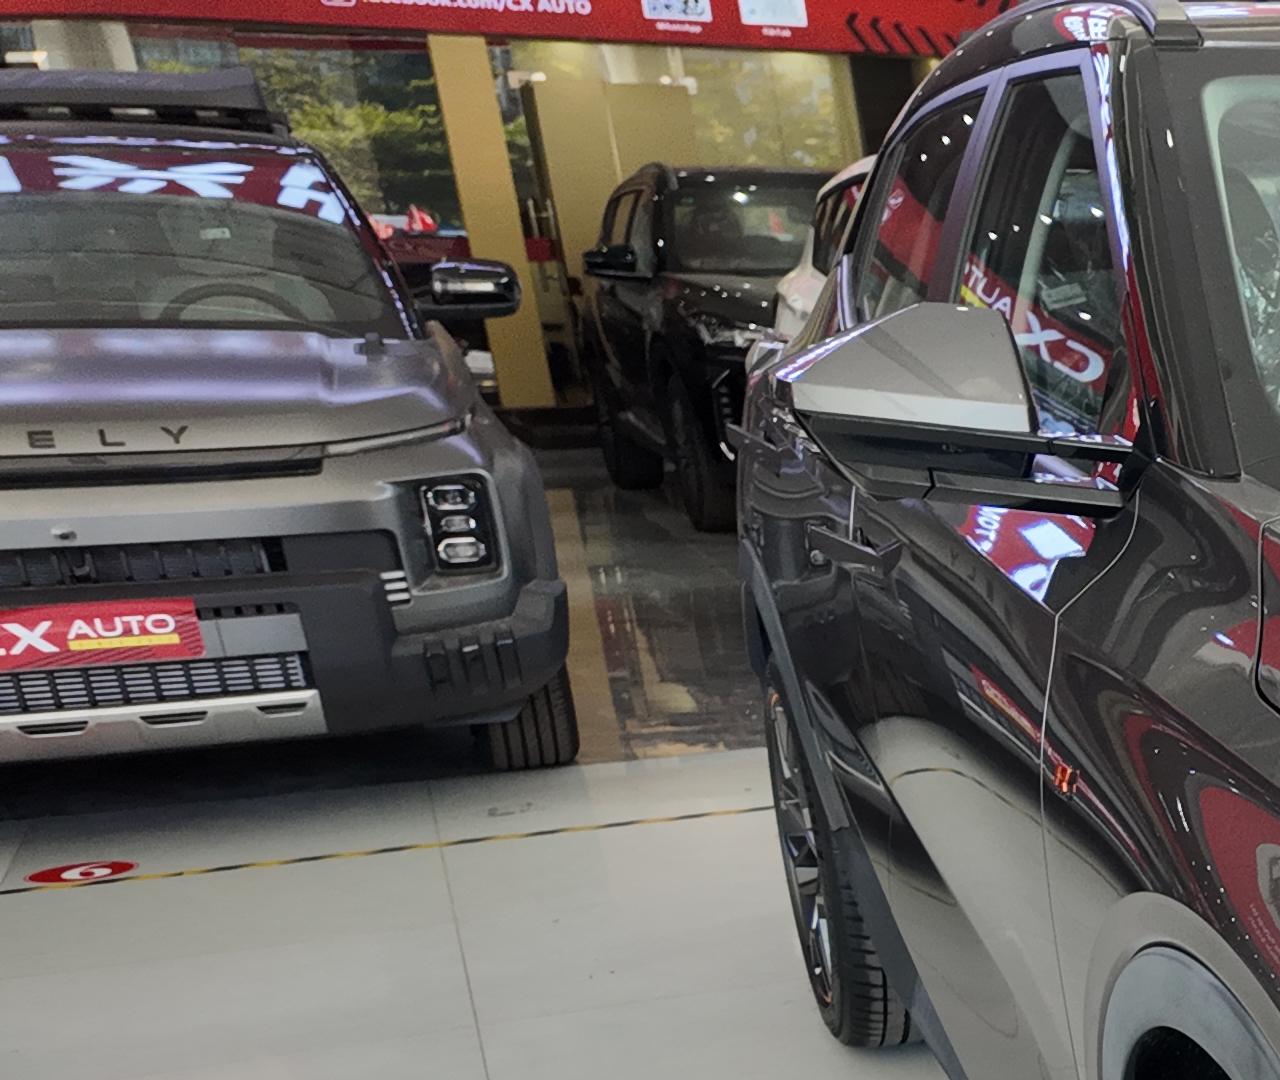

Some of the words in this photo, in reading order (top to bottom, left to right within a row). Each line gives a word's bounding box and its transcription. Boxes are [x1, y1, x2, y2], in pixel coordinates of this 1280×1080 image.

[537, 0, 592, 15] AUTO
[27, 425, 188, 449] ELY
[0, 620, 60, 656] X
[67, 613, 176, 640] AUTO
